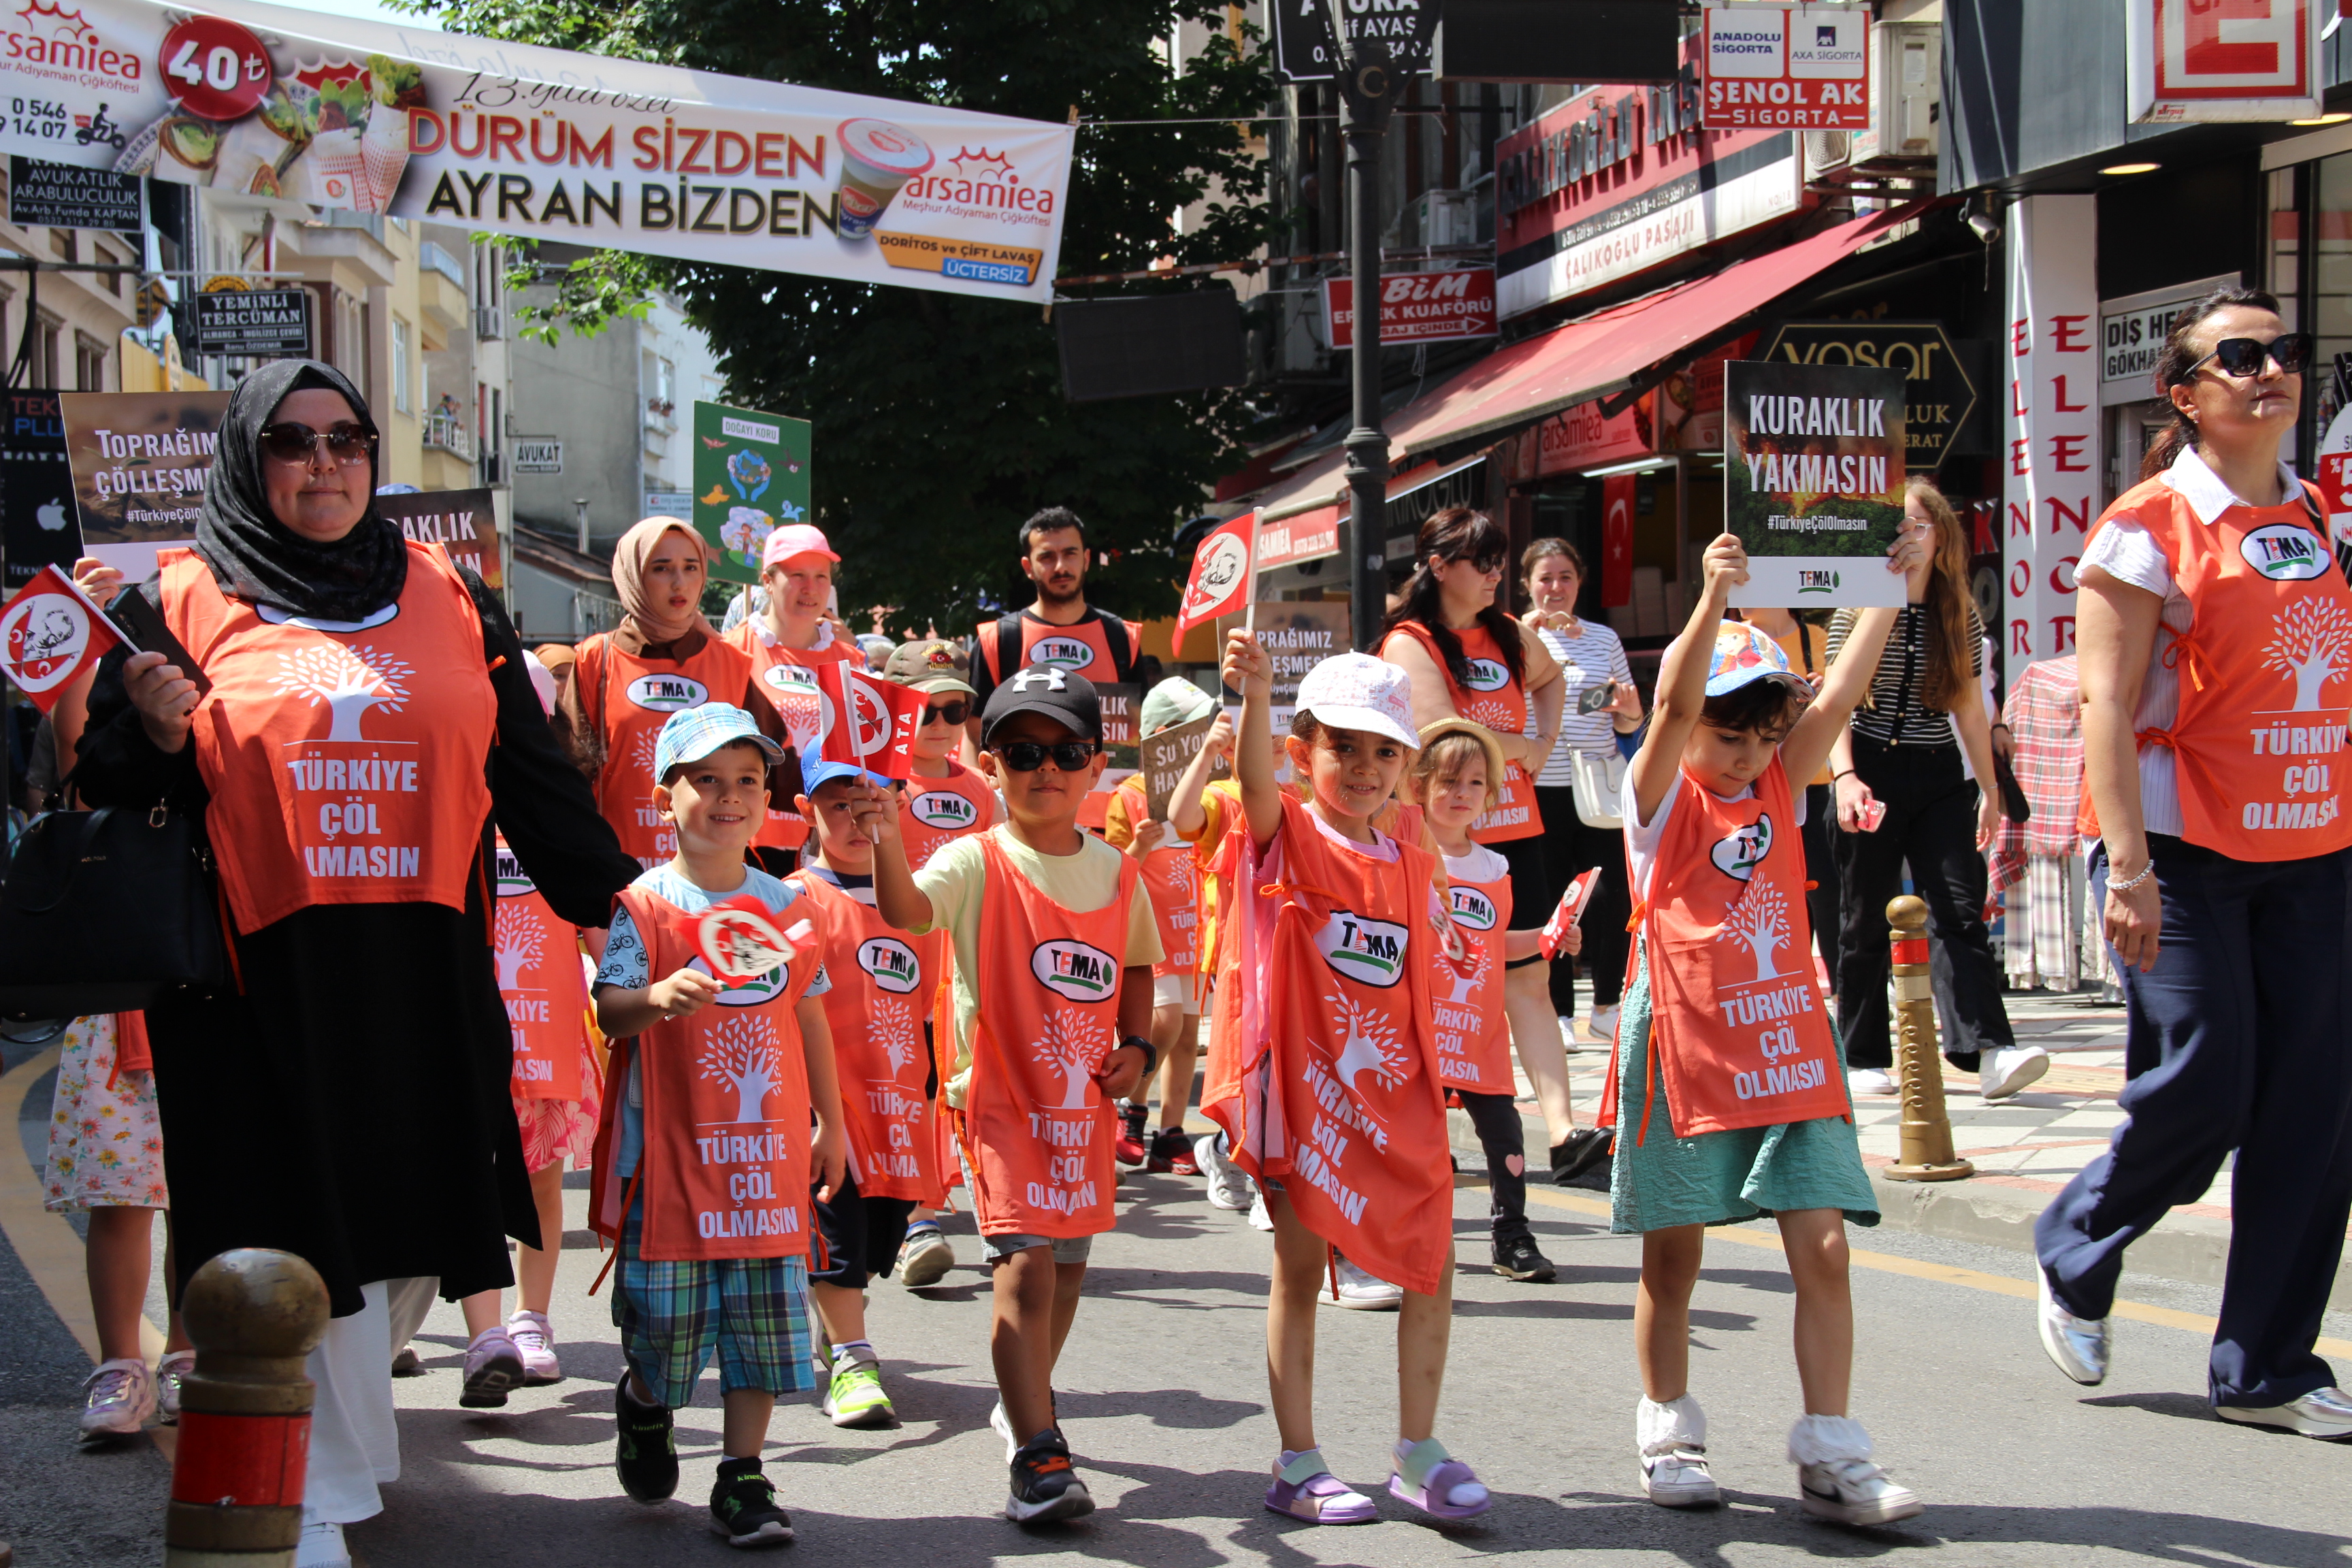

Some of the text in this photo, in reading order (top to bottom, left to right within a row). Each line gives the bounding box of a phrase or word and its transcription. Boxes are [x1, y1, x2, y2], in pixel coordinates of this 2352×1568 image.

[1364, 16, 1416, 37] AYAŞ
[1712, 33, 1781, 42] ANADOLU
[0, 31, 141, 80] samiea
[1712, 42, 1773, 54] SİGORTA
[1792, 50, 1863, 60] AXA SİGORTA
[15, 63, 76, 83] Adıyaman
[80, 74, 140, 94] Çiğköftesi
[12, 97, 67, 119] 0 546
[1709, 82, 1863, 110] ŞENOL AK
[13, 118, 37, 136] 14
[42, 121, 67, 140] 07
[1733, 109, 1840, 125] SİGORTA
[408, 103, 824, 178] DÜRÜM SİZDEN
[30, 169, 122, 188] AVUKATLIK
[14, 184, 137, 205] ARABULUCULUK
[426, 169, 840, 238] AYRAN BİZDEN
[906, 174, 1053, 214] arsamiea
[95, 208, 138, 220] KAPTAN
[902, 200, 1051, 227] Meşhur Adıyaman Çiğköftesi
[880, 235, 938, 252] DORİTOS
[961, 244, 988, 258] ÇİFT
[992, 250, 1034, 263] LAVAŞ
[1566, 233, 1640, 287] ÇALIKOĞLU
[1645, 209, 1695, 250] PASAJI
[947, 260, 1025, 283] ÜCTERSİZ
[202, 309, 300, 325] TERCÜMAN
[1403, 297, 1492, 318] KUAFÖRÜ
[203, 330, 237, 339] ALMANCA
[243, 328, 278, 338] İNGİLİZCE
[2108, 314, 2178, 348] DİŞ HE
[2109, 350, 2159, 377] GÖKHA
[11, 397, 62, 416] TEK
[1750, 395, 1885, 438] KURAKLIK
[1906, 405, 1950, 423] LUK
[15, 418, 65, 436] PLU
[725, 421, 777, 440] DOĞAYI KORU
[95, 427, 218, 459] TOPRAĞIM
[518, 446, 560, 461] AVUKAT
[95, 467, 212, 501] ÇÖLLEŞM
[1746, 453, 1886, 494] YAKMASIN
[1767, 514, 1867, 534] #TürkiyeÇölOlmasın
[2256, 536, 2310, 559] TEMA
[1799, 570, 1830, 587] TEMA
[1043, 643, 1078, 659] TEMA
[1258, 627, 1333, 649] PRAĞIMIZ
[644, 682, 685, 697] TEMA
[778, 669, 812, 685] TEMA
[1277, 714, 1294, 723] TEM
[895, 713, 911, 755] ATA
[2250, 719, 2347, 755] TÜRKİY
[1156, 744, 1176, 767] SU
[287, 751, 418, 793] TÜRKİYE
[2283, 760, 2330, 798] ÇÖL
[926, 798, 961, 815] TEMA
[1499, 783, 1515, 804] ÖL
[320, 796, 381, 841] ÇÖL
[304, 847, 420, 877] LMASIN
[1454, 892, 1486, 917] TEMA
[1051, 949, 1100, 981] TEMA
[508, 995, 549, 1022] KİYE
[1720, 981, 1813, 1028] TÜRKİYE
[1433, 1002, 1482, 1036] ÜRKİYE
[1435, 1030, 1465, 1056] ÇÖL
[1759, 1022, 1800, 1065] ÇÖL
[514, 1059, 553, 1081] ASIN
[1733, 1058, 1825, 1100] OLMASIN
[696, 1130, 787, 1166] TÜRKİYE
[1311, 1113, 1348, 1169] ÇÖL
[1050, 1150, 1085, 1186] ÇÖL
[730, 1166, 777, 1208] ÇÖL
[698, 1206, 798, 1239] OLMASIN
